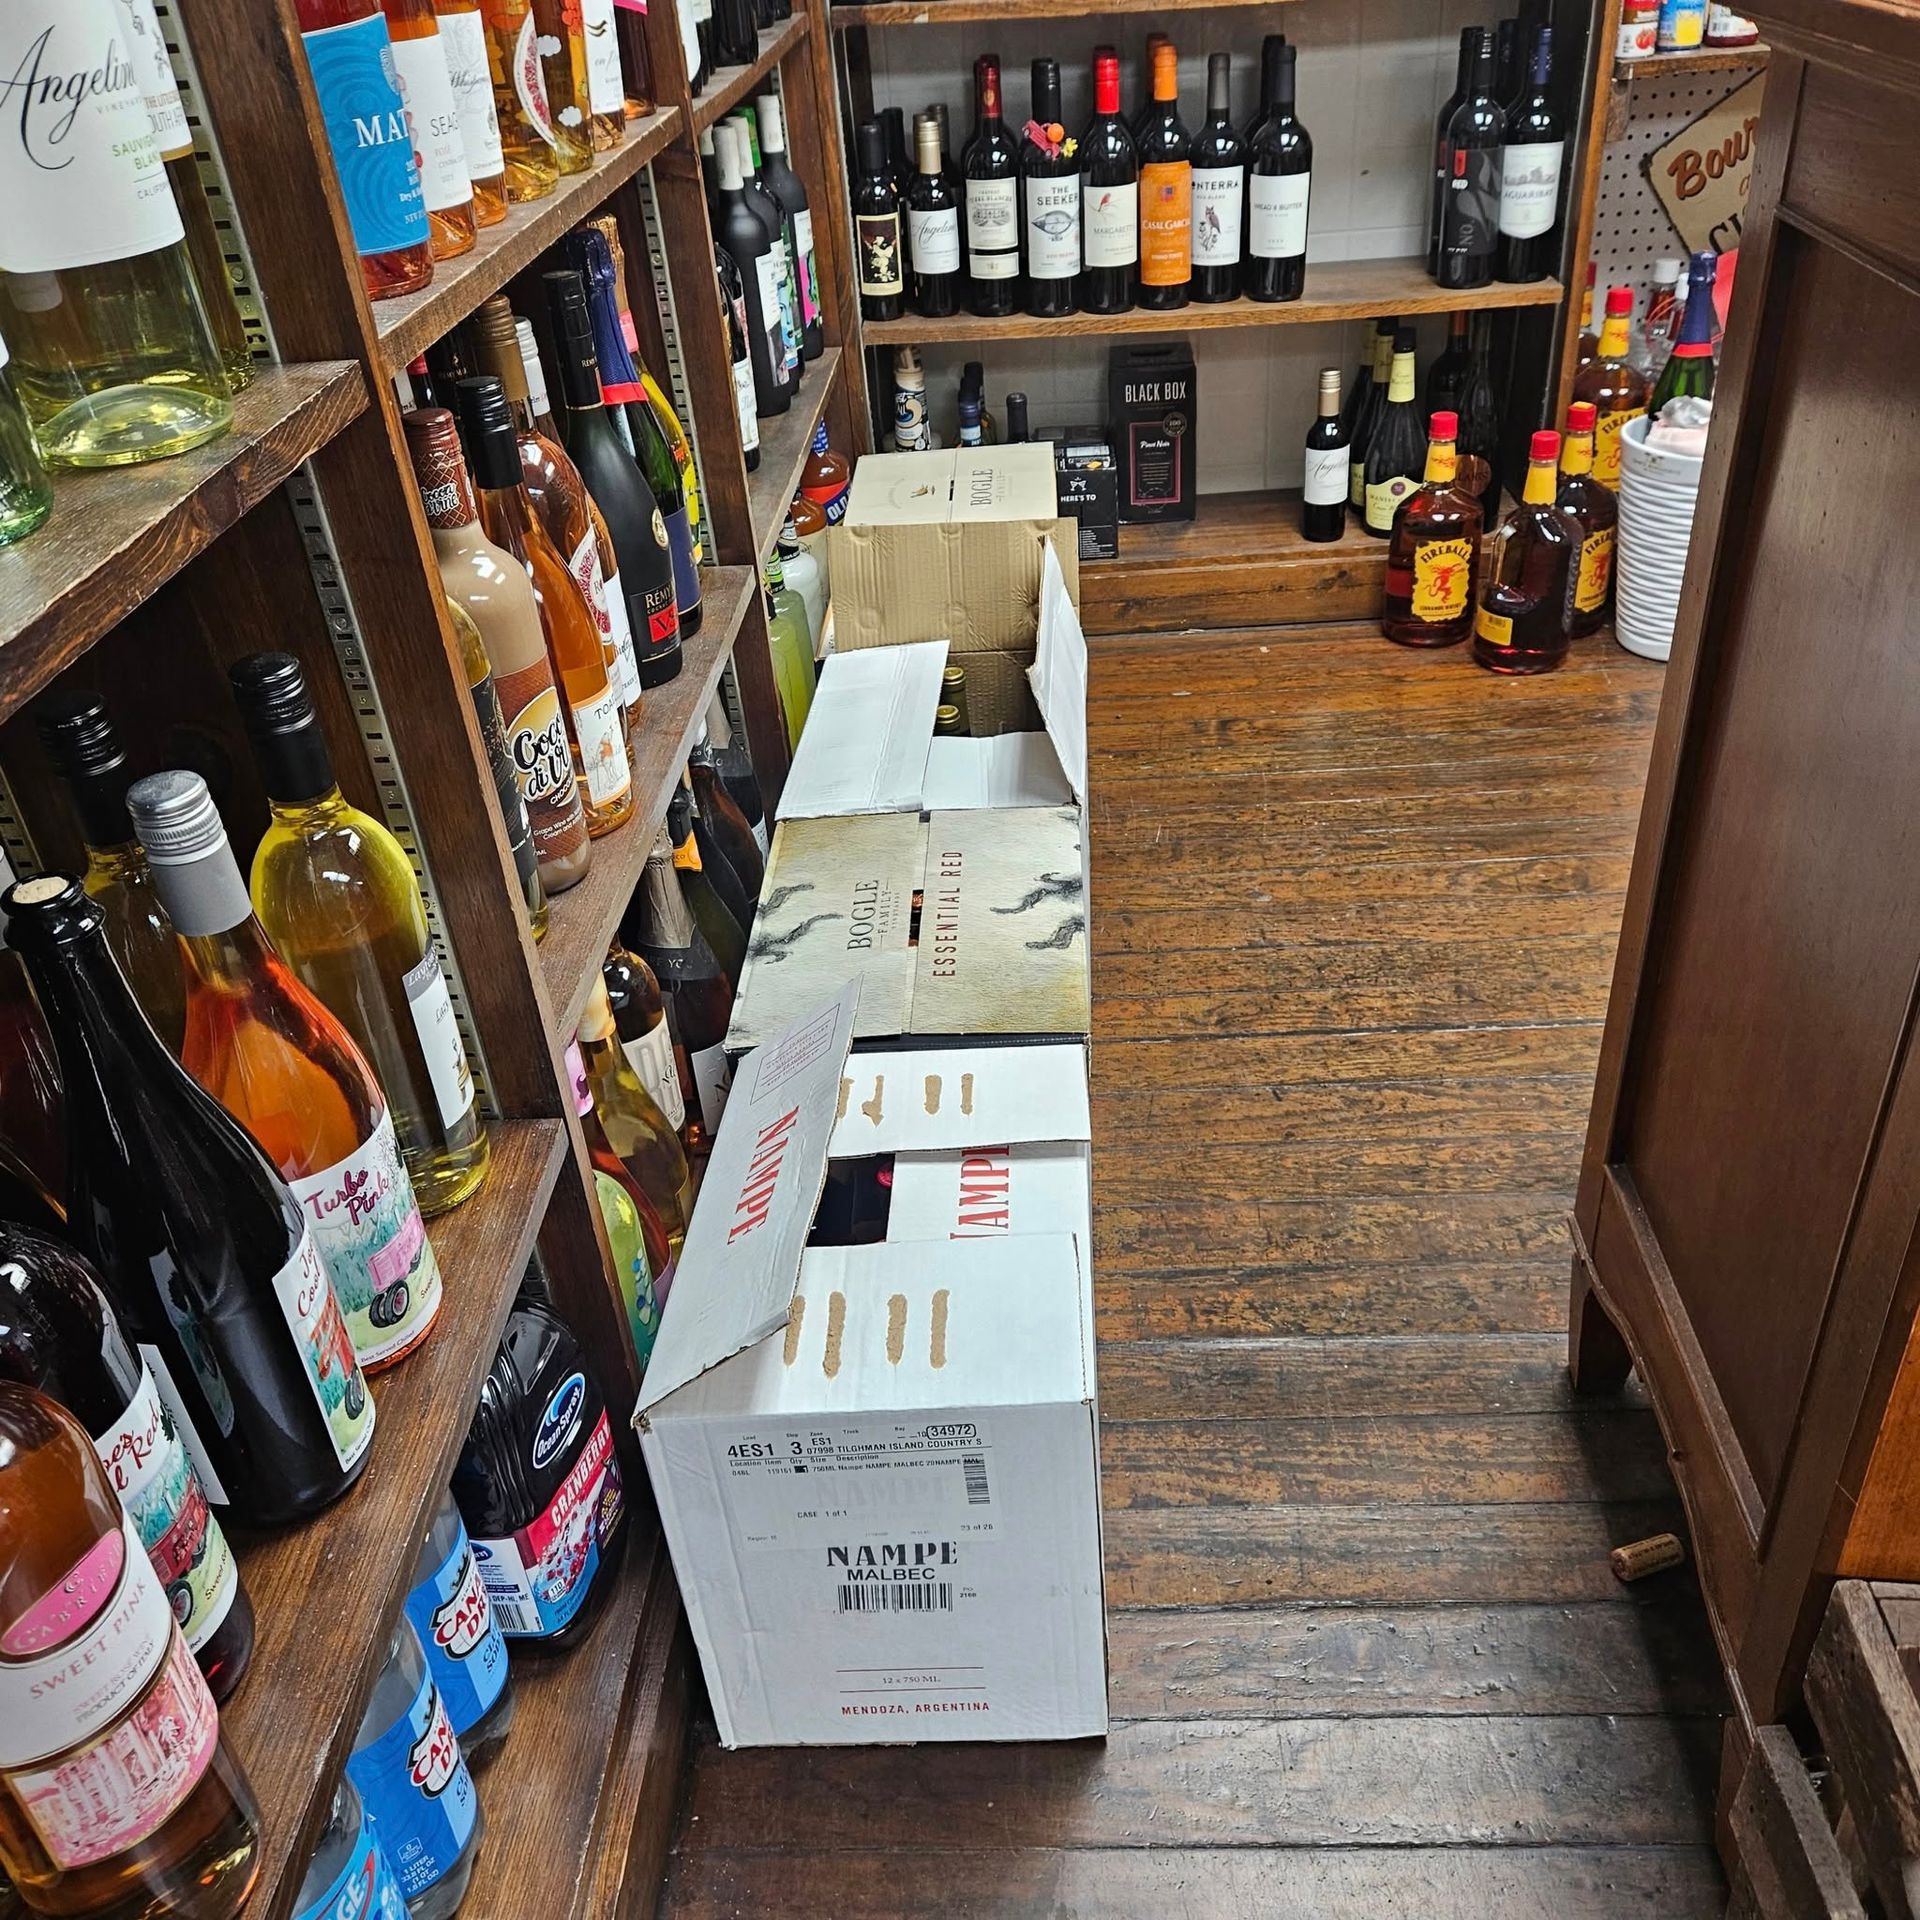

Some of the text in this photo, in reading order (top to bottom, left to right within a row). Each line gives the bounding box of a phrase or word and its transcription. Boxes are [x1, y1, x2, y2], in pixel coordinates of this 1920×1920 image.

[1125, 382, 1186, 402] BLACK BOX
[970, 468, 993, 506] BOGLE
[1060, 494, 1085, 502] HERE'S
[1420, 545, 1470, 564] FIREBALL
[847, 880, 878, 950] BOGLE
[878, 890, 892, 934] FAMILY
[933, 852, 962, 977] ESSENTIAL RED
[727, 1105, 799, 1246] NAMPE
[304, 1169, 369, 1220] Turbo
[345, 1170, 388, 1226] Pink
[537, 1386, 581, 1459] Ocean Spray
[930, 1424, 972, 1437] 34972
[728, 1442, 775, 1458] 4ES1
[790, 1441, 803, 1456] 3
[811, 1437, 833, 1447] ES1
[837, 1442, 886, 1454] TILGHMAN
[889, 1440, 924, 1451] ISLAND
[927, 1438, 972, 1448] COUNTRY
[976, 1437, 983, 1446] S
[730, 1460, 762, 1468] Location
[764, 1458, 782, 1466] Item
[790, 1456, 803, 1465] Qty
[836, 1454, 879, 1462] Description
[865, 1461, 892, 1470] NAMPE
[894, 1459, 924, 1468] MALBEC
[552, 1418, 612, 1529] CRANBERRY
[797, 1511, 818, 1519] CASE
[832, 1510, 841, 1518] of
[826, 1541, 958, 1568] NAMPE
[847, 1568, 936, 1581] MALBEC
[550, 1581, 562, 1595] 110
[30, 1576, 148, 1700] SWEET PINK
[904, 1675, 921, 1683] 750
[841, 1702, 990, 1716] MENDOZA, ARGENTINA
